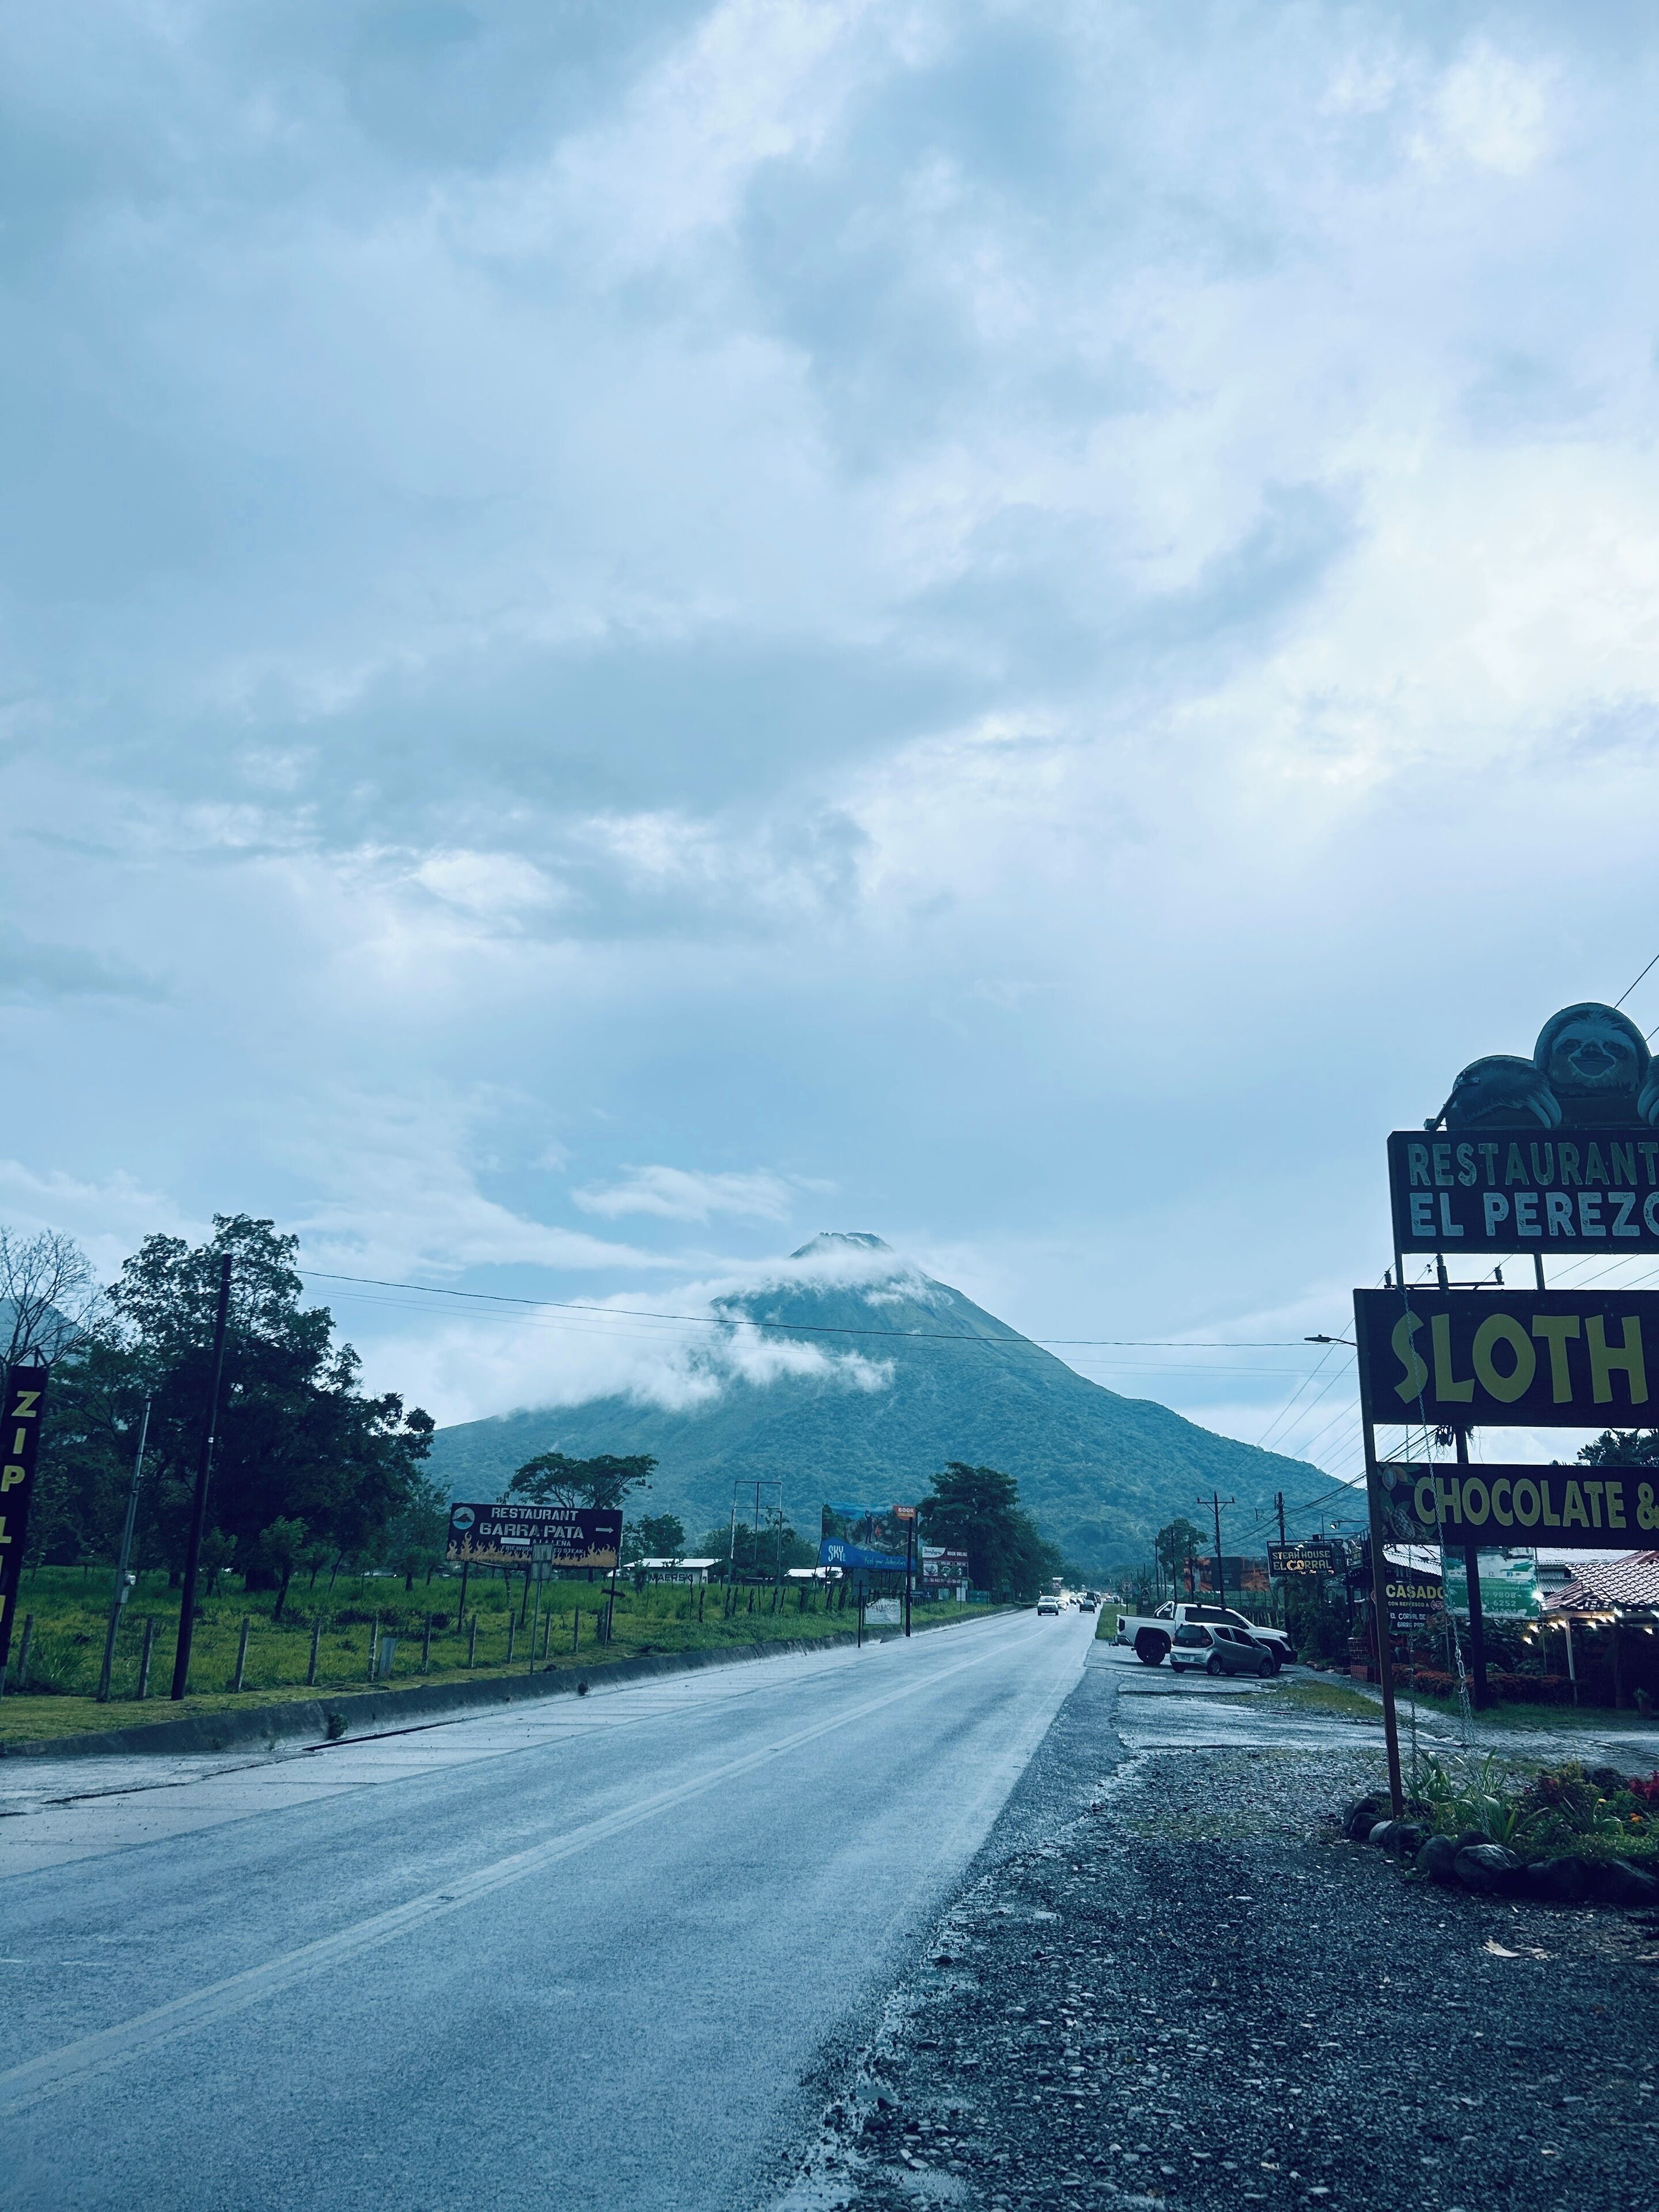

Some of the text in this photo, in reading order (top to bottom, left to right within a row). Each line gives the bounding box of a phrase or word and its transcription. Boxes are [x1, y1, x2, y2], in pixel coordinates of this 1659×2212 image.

[1407, 1142, 1659, 1187] RESTAURANT
[1410, 1192, 1464, 1236] EL
[1391, 1310, 1649, 1404] SLOTH
[1, 1391, 41, 1492] ZIP
[491, 1507, 578, 1521] RESTAURANT
[1414, 1476, 1627, 1529] CHOCOLATE
[828, 1545, 844, 1562] SKY
[1273, 1559, 1332, 1571] EL CORRAL
[1301, 1550, 1331, 1558] HOUSE
